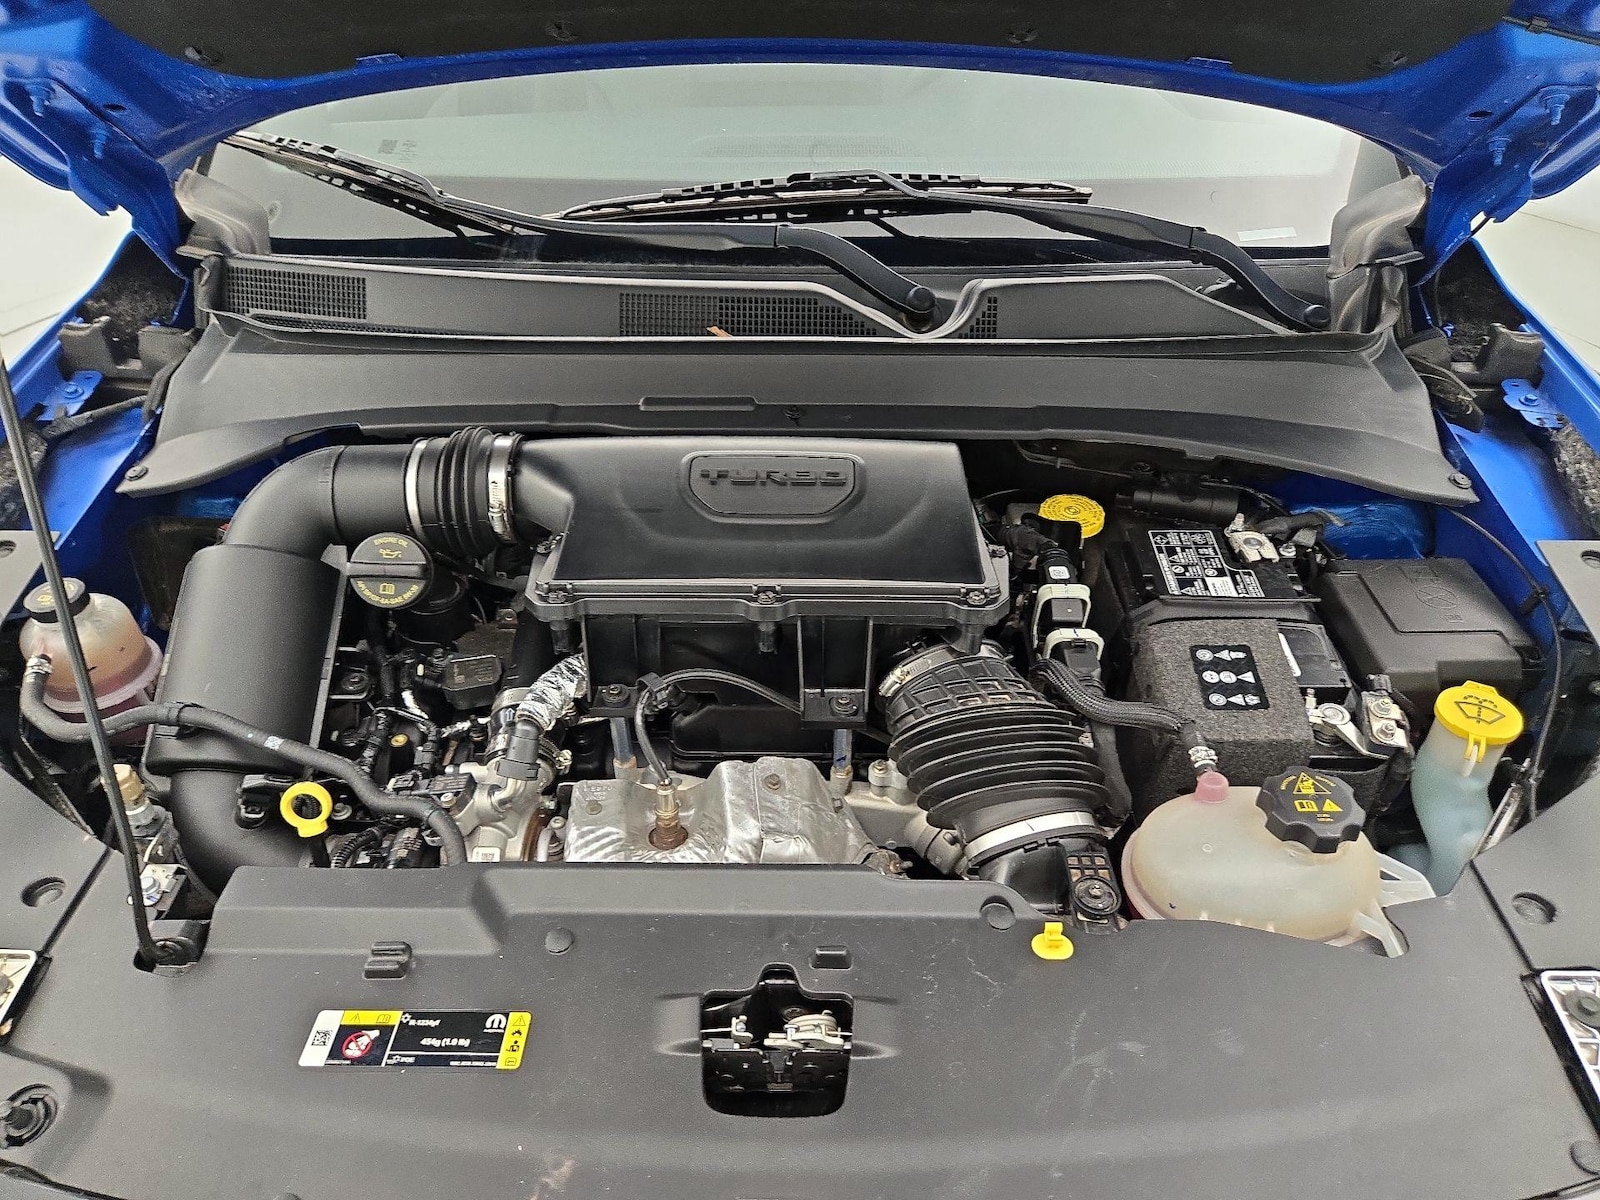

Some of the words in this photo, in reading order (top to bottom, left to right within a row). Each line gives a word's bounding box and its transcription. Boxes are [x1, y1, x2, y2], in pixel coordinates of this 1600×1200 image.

[700, 469, 846, 487] TURBO
[374, 537, 398, 546] ENGINE
[398, 539, 408, 548] OIL
[420, 1037, 441, 1048] 454g
